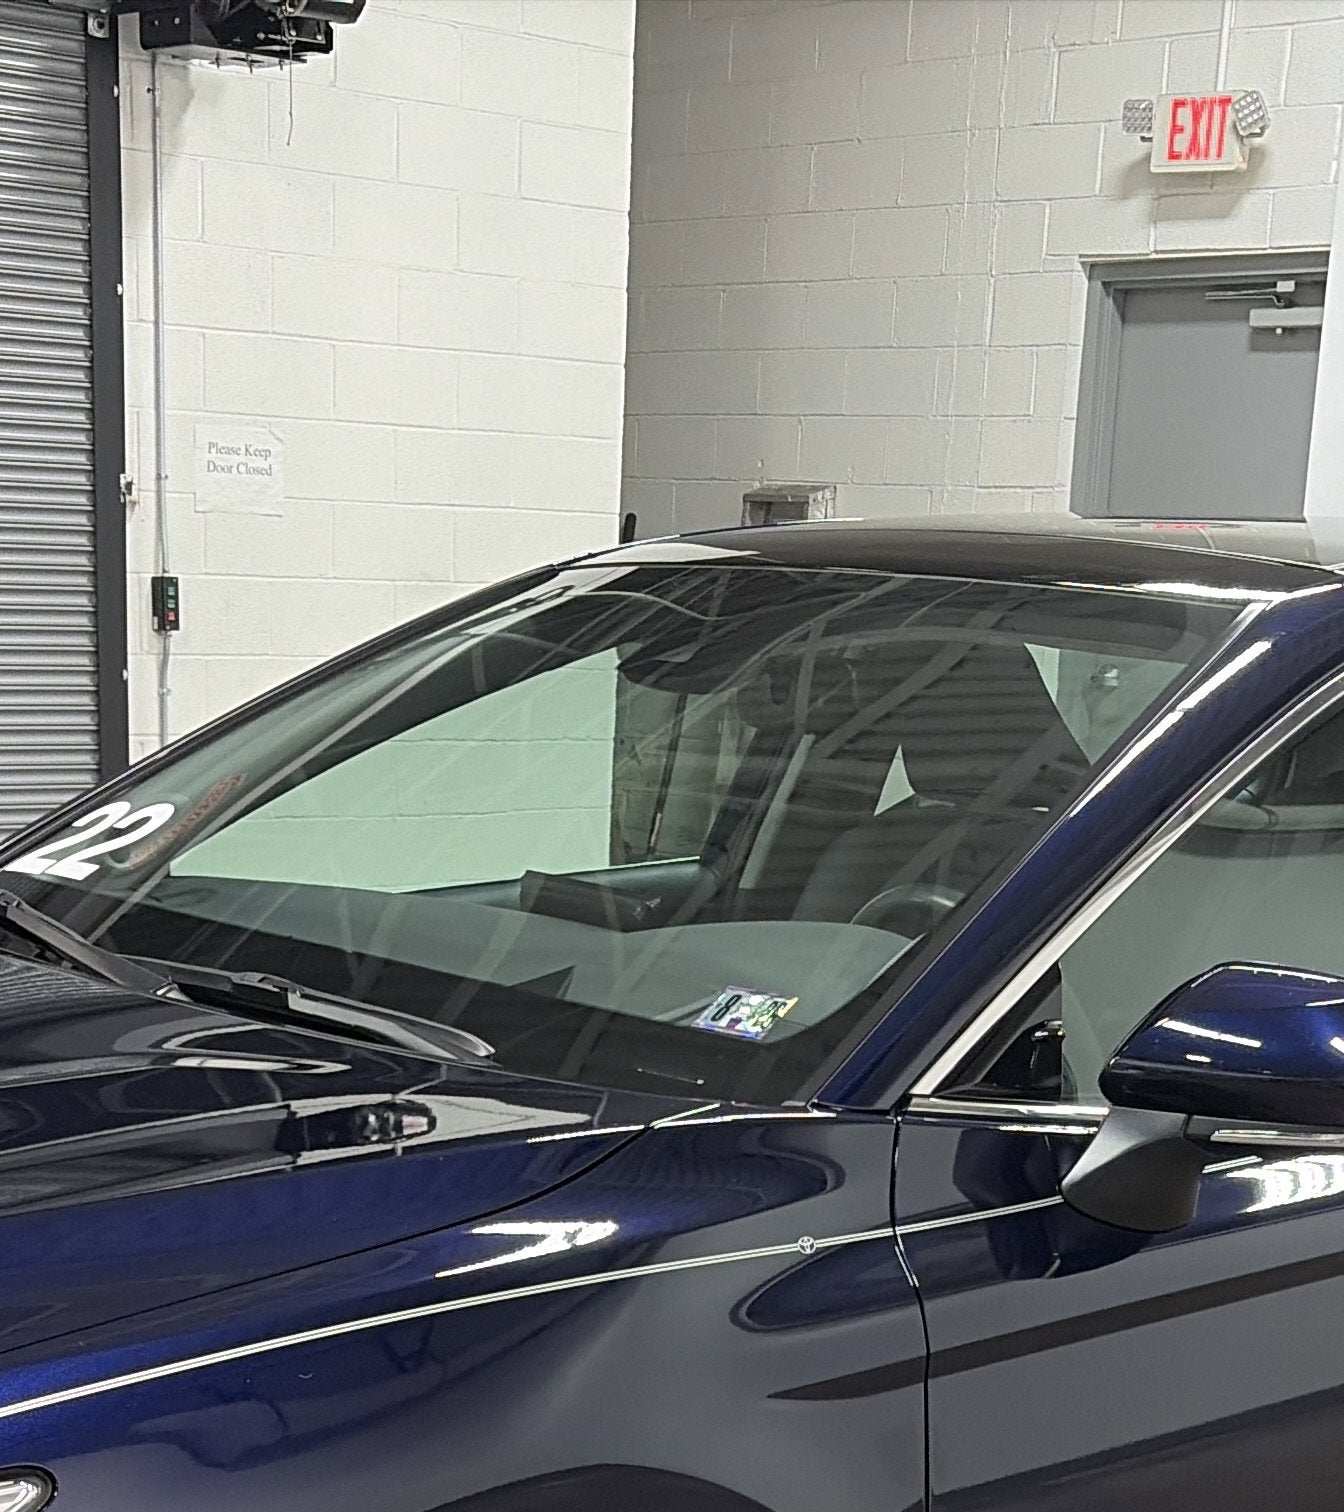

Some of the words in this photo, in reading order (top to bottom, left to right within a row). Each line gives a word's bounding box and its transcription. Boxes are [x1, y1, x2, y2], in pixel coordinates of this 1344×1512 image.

[1167, 96, 1232, 160] EXIT
[208, 441, 241, 457] Please
[244, 444, 272, 461] Keep
[207, 460, 234, 474] Door
[236, 463, 273, 477] Closed
[4, 801, 175, 881] 22
[710, 994, 742, 1021] 8
